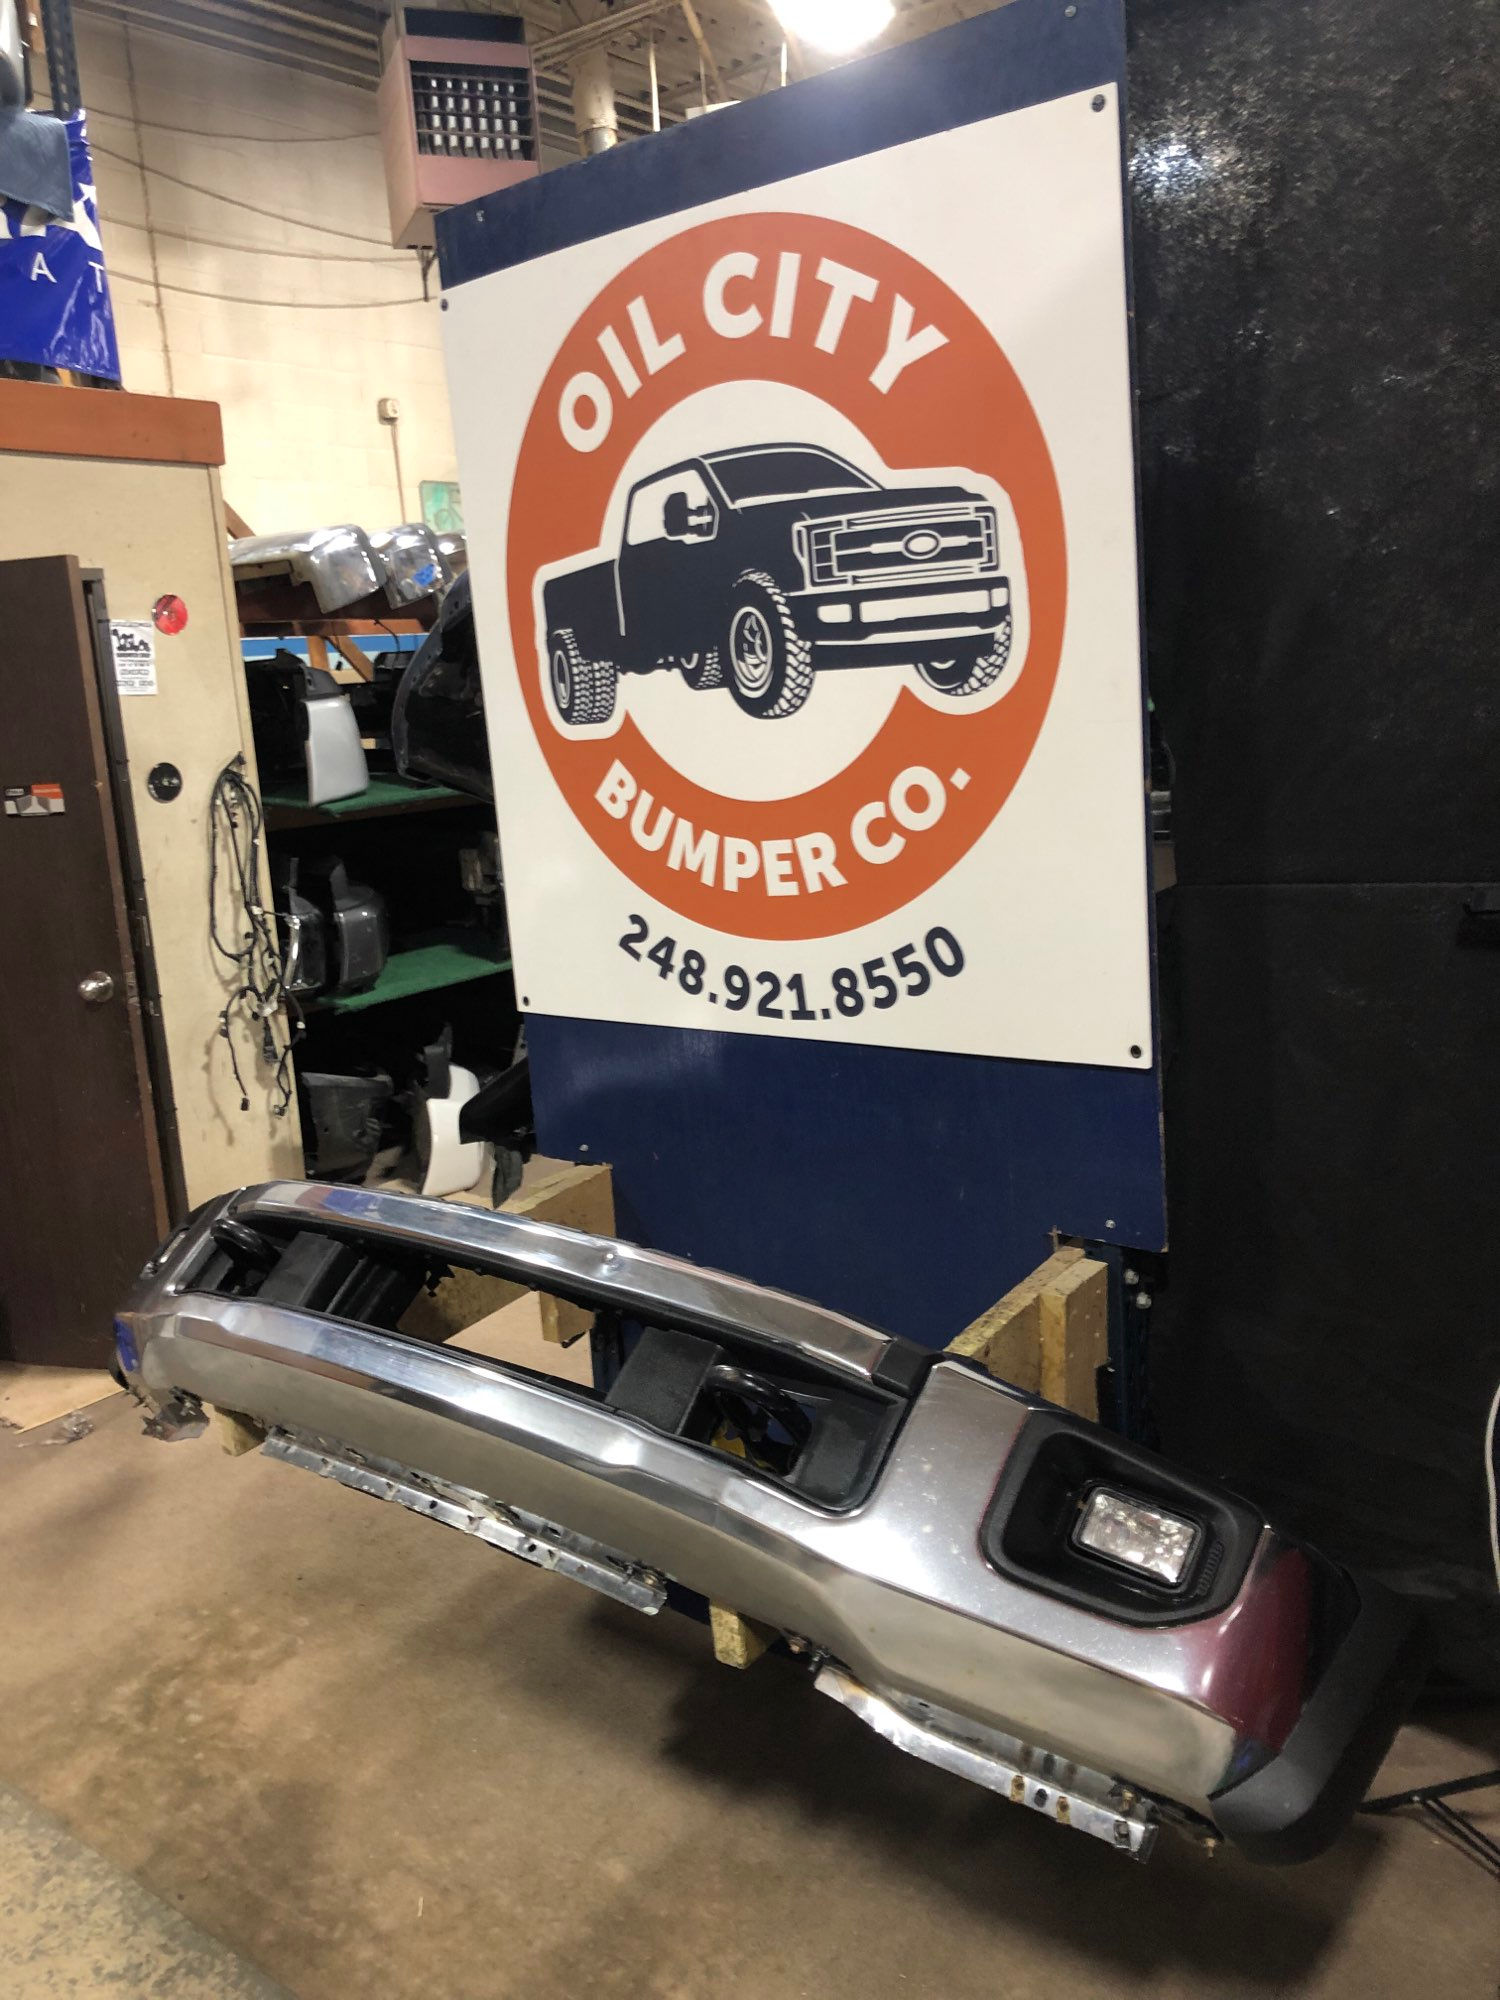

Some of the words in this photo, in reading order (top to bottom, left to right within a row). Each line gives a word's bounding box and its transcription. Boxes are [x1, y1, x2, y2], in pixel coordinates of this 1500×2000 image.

[558, 295, 686, 453] OIL
[703, 251, 950, 394] CITY
[594, 758, 848, 897] BUMPER
[850, 765, 971, 865] CO.
[618, 913, 965, 1021] 248.921.8550
